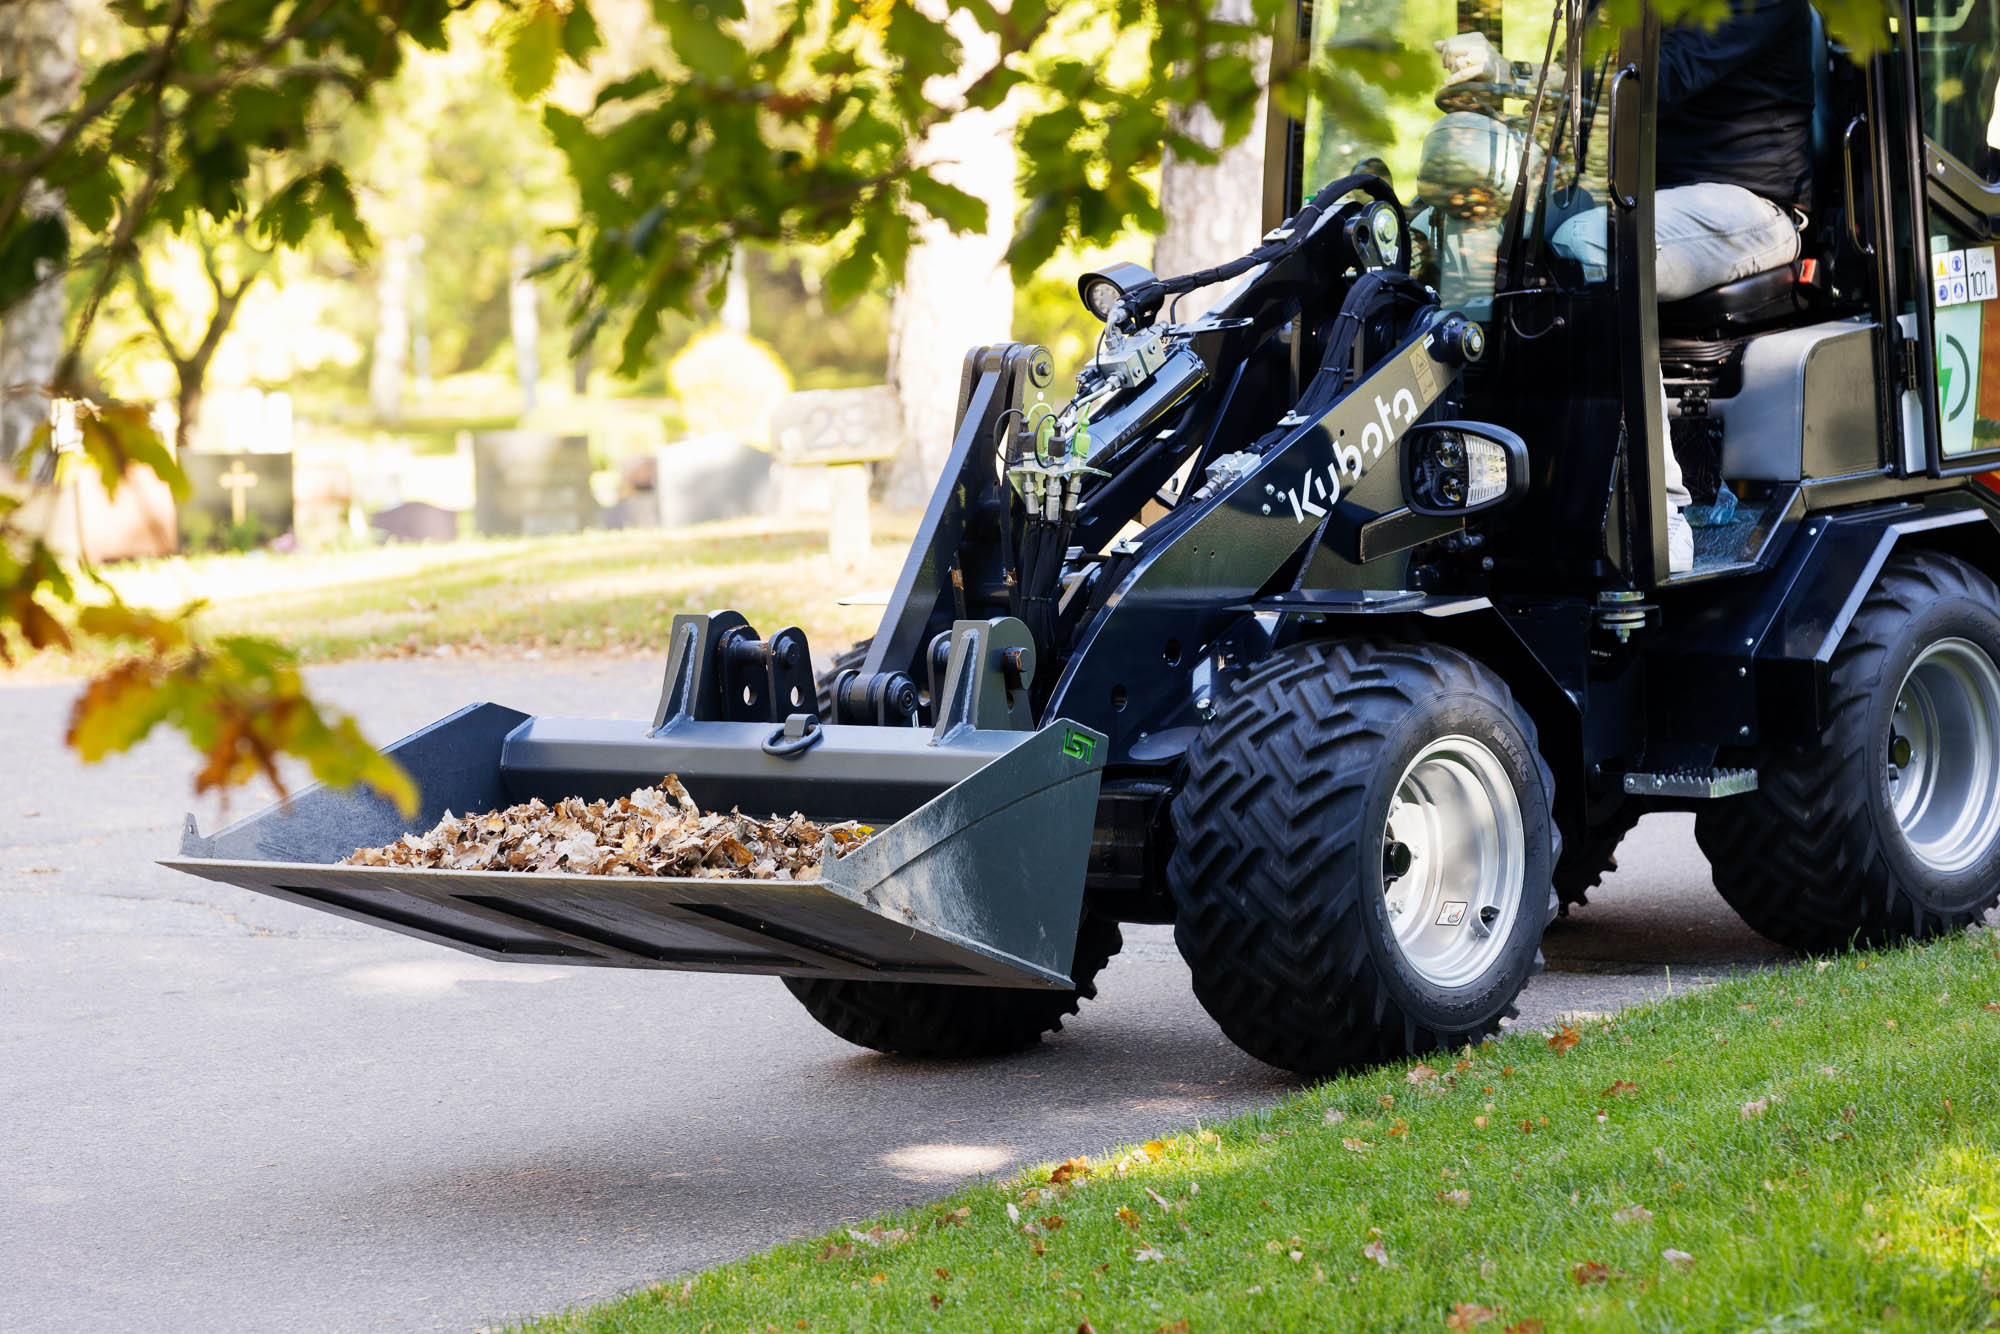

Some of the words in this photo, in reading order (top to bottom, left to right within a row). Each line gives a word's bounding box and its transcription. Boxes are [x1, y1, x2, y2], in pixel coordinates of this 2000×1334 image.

[1970, 270, 1988, 297] 101
[1288, 388, 1419, 524] Kubota
[1491, 725, 1530, 783] MITAS
